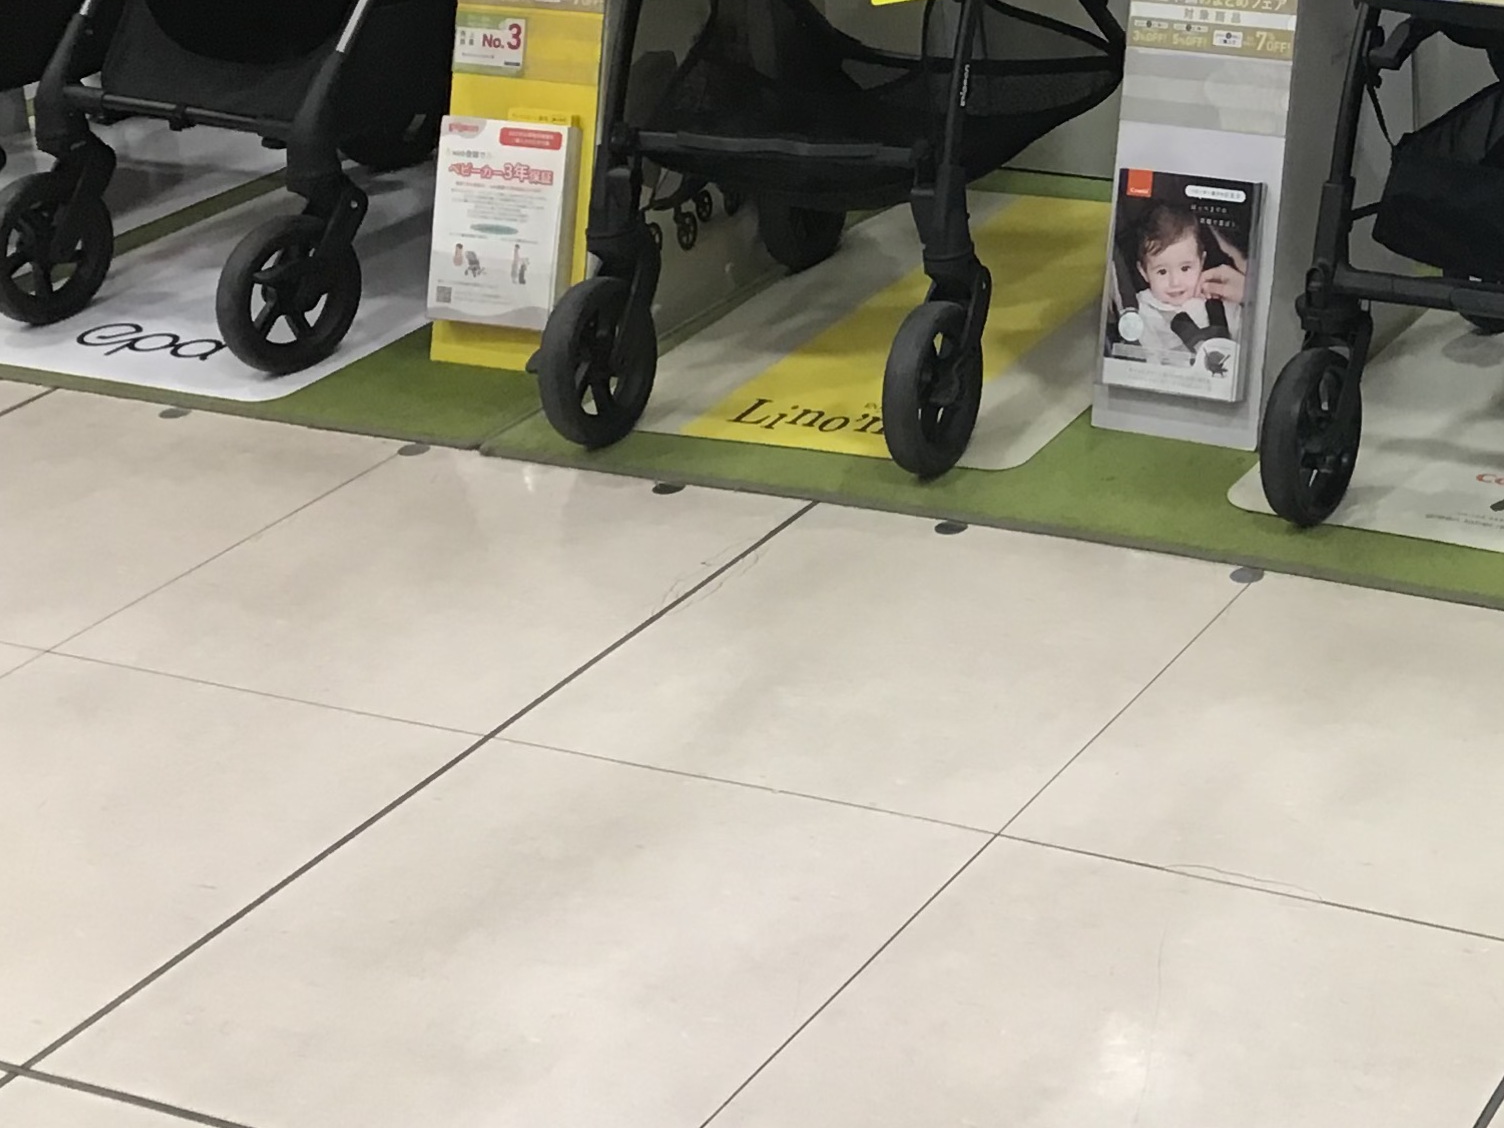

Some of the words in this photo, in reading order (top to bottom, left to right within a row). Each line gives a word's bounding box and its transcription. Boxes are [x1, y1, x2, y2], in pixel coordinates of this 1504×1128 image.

[448, 162, 554, 186] ベビーカー3年保証
